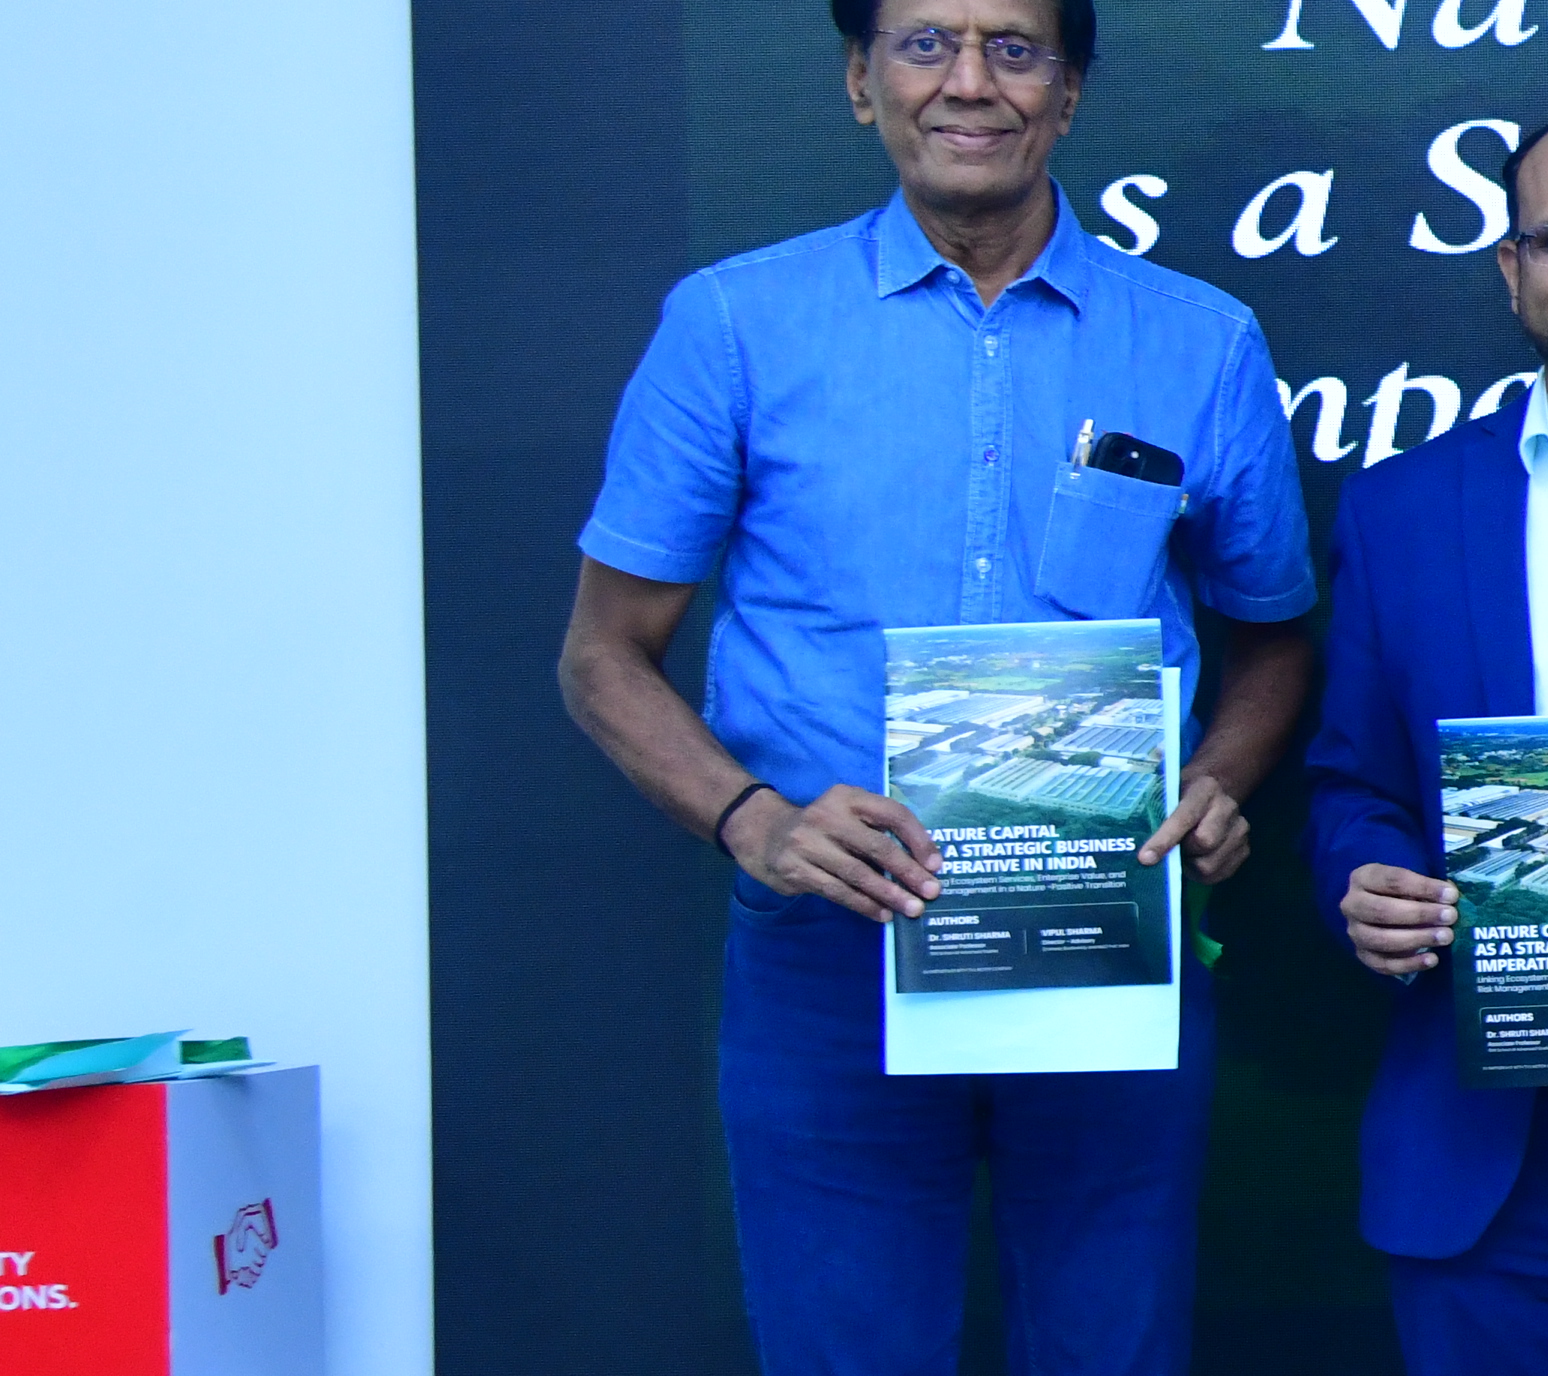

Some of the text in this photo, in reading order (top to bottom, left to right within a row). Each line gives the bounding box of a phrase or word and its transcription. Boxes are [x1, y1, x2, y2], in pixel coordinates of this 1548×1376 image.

[1098, 173, 1169, 257] s
[1231, 168, 1340, 259] a
[926, 825, 1059, 842] ATURE CAPITAL
[945, 838, 1136, 858] A STRATEGIC BUSINESS
[937, 856, 1096, 875] PERATIVE IN INDIA
[929, 916, 979, 926] AUTHORS
[1474, 926, 1538, 940] NATURE
[1475, 944, 1496, 957] AS
[1500, 943, 1512, 955] A
[1486, 1013, 1534, 1023] AUTHORS
